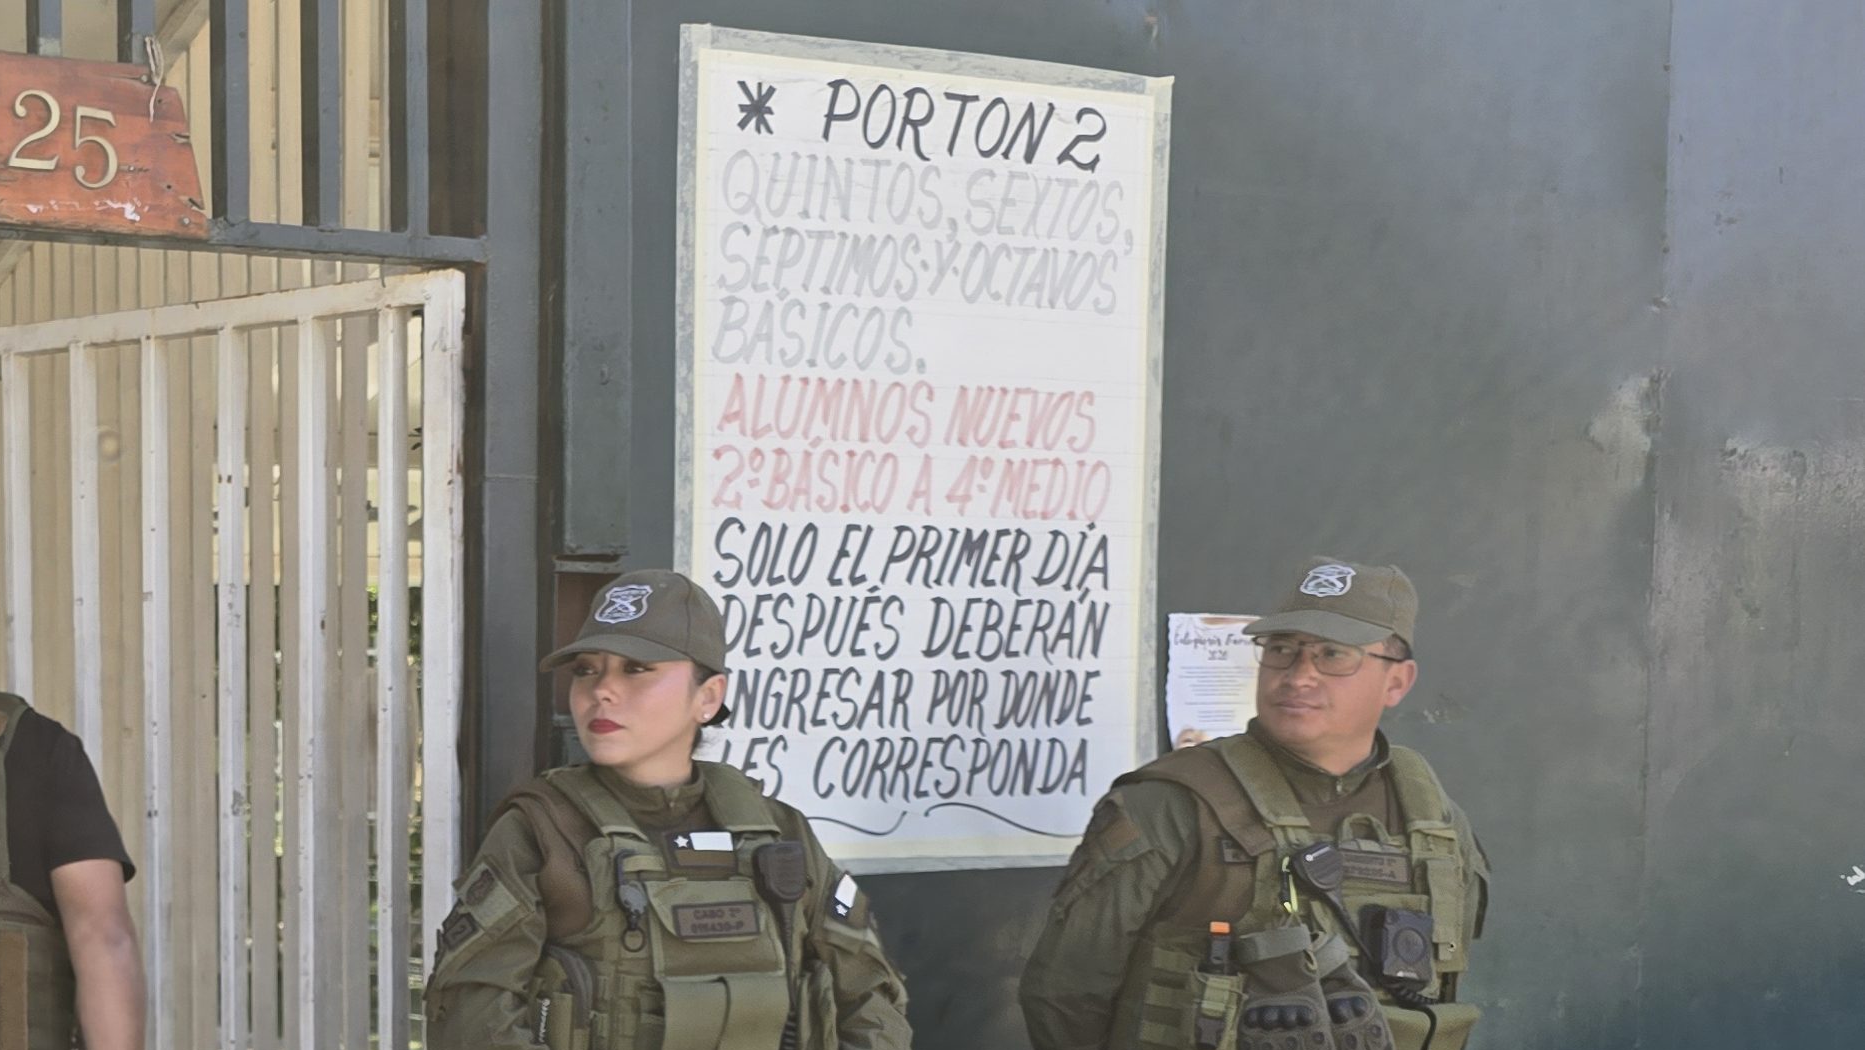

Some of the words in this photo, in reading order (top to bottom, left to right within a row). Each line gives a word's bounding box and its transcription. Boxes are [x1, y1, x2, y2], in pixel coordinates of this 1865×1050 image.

[822, 78, 1054, 164] PORTON
[1056, 106, 1107, 173] 2
[721, 149, 959, 242] QUINTOS,
[960, 240, 1118, 316] OCTAVOS
[716, 372, 934, 449] ALUMNOS
[943, 384, 1097, 453] NUEVOS
[761, 435, 900, 514] BÁSICO
[906, 452, 933, 517] A
[989, 457, 1113, 523] MEDIO
[712, 516, 819, 589] SOLO
[826, 523, 875, 588] EL
[879, 524, 1032, 597] PRIMER
[1031, 521, 1110, 592] DÍA
[722, 584, 905, 661] DESPUÉS
[921, 587, 1111, 665] DEBERÁN
[716, 666, 914, 736] NGRESAR
[926, 666, 989, 738] POR
[993, 668, 1102, 731] DONDE
[812, 733, 1089, 804] CORRESPONDA
